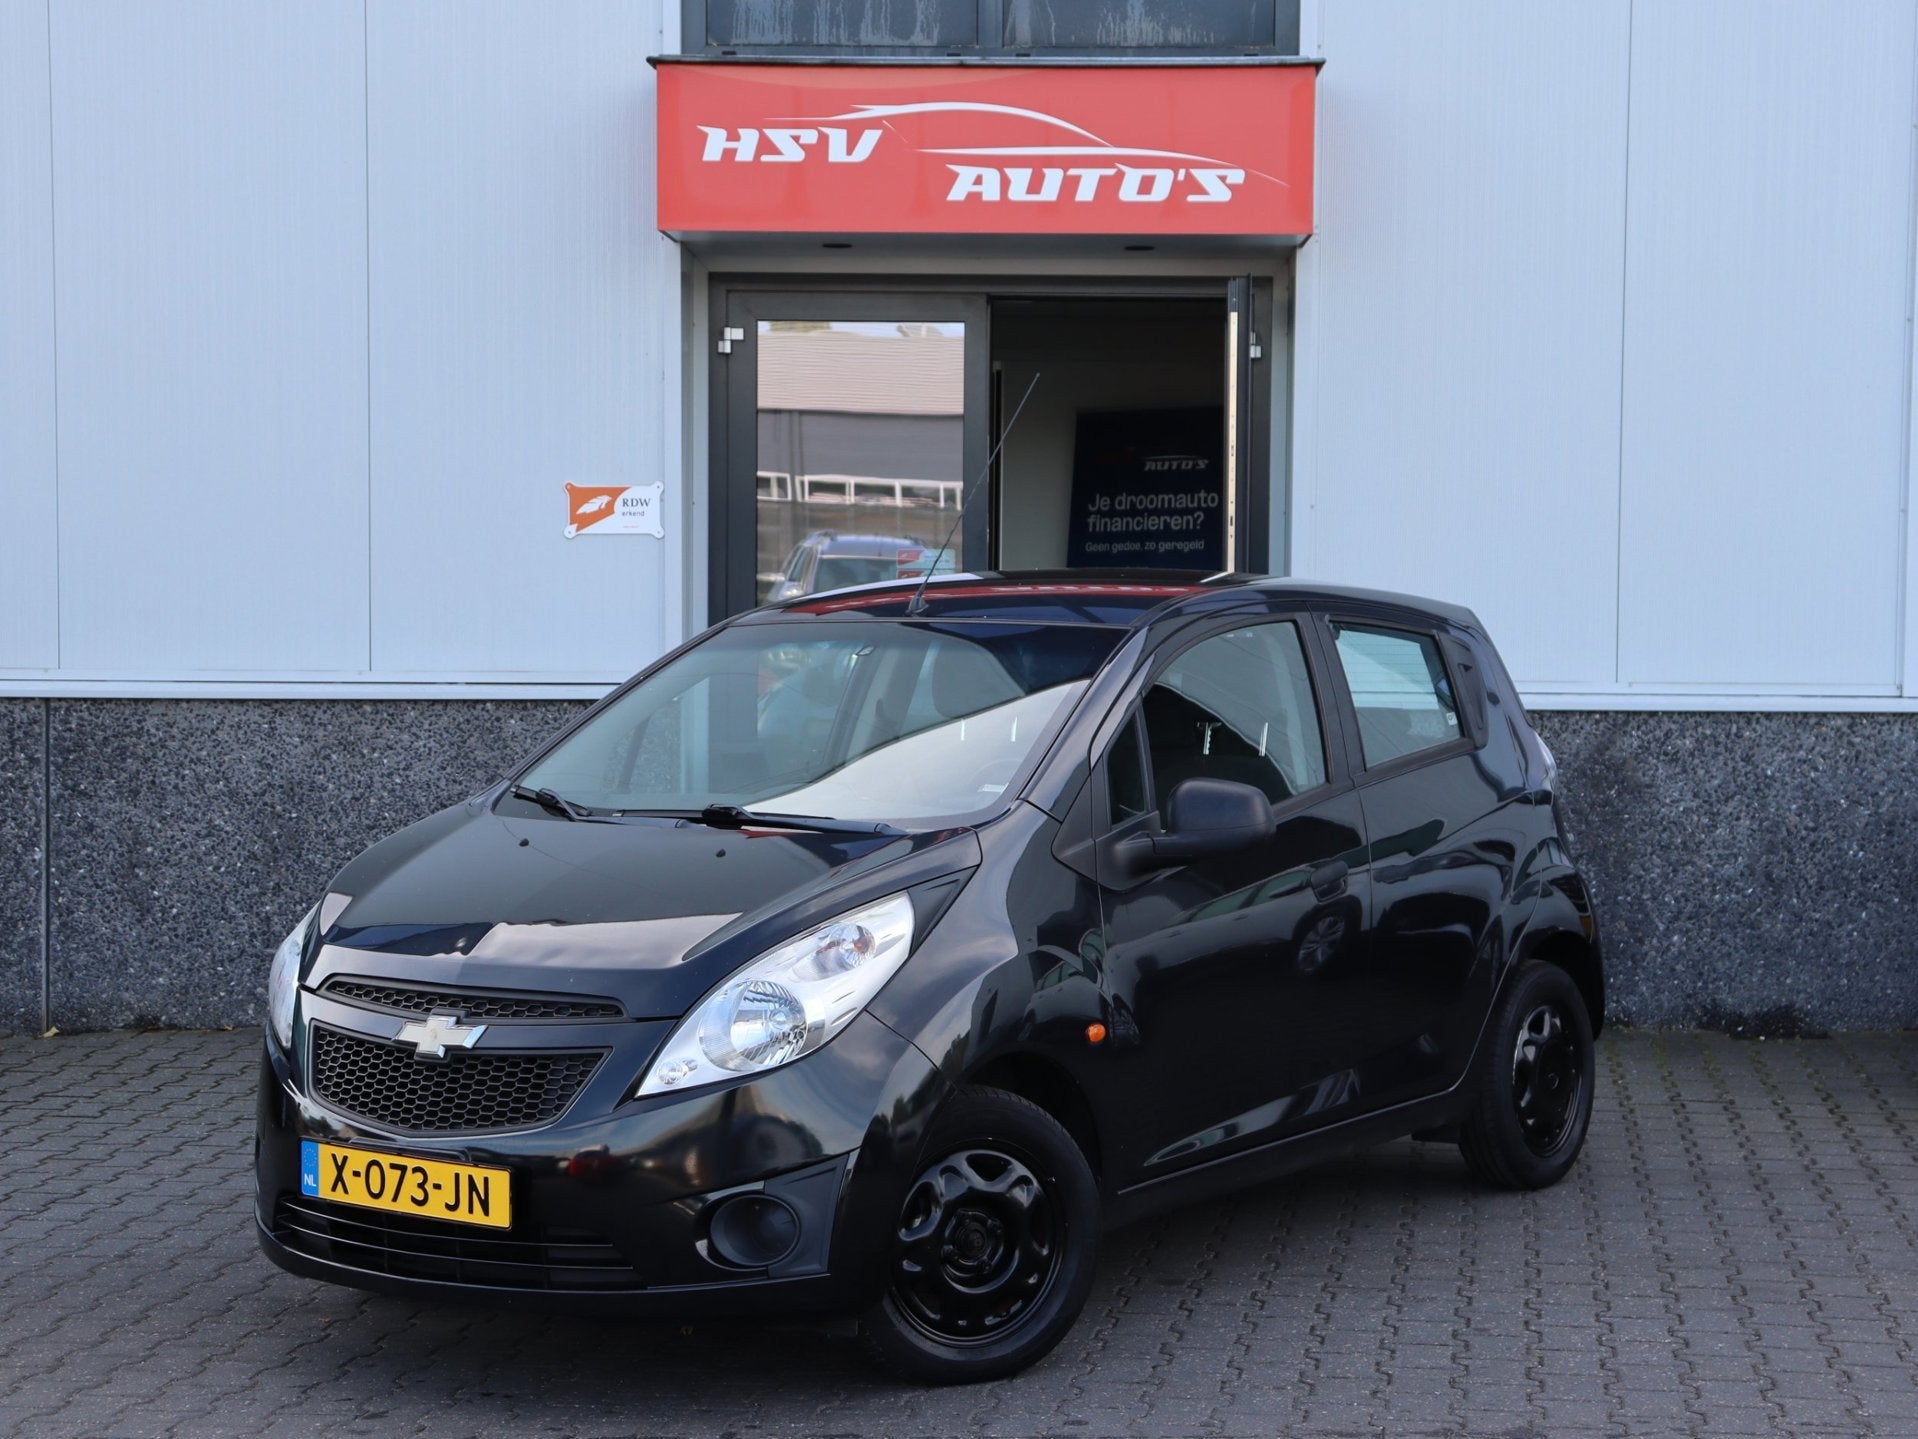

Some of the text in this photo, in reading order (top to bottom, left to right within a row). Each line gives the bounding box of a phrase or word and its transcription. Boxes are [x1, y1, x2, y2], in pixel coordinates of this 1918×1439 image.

[697, 125, 882, 163] HSV
[945, 163, 1246, 203] AUTO'S
[1143, 459, 1209, 471] AUTO'S
[622, 498, 651, 508] RDW
[1088, 489, 1219, 511] Je droomauto
[1087, 511, 1205, 533] financieren?
[1085, 542, 1110, 552] Geen
[1144, 541, 1156, 550] zo
[1158, 539, 1205, 552] geregeld
[304, 1173, 317, 1188] NL
[330, 1152, 490, 1217] X-073-JN
